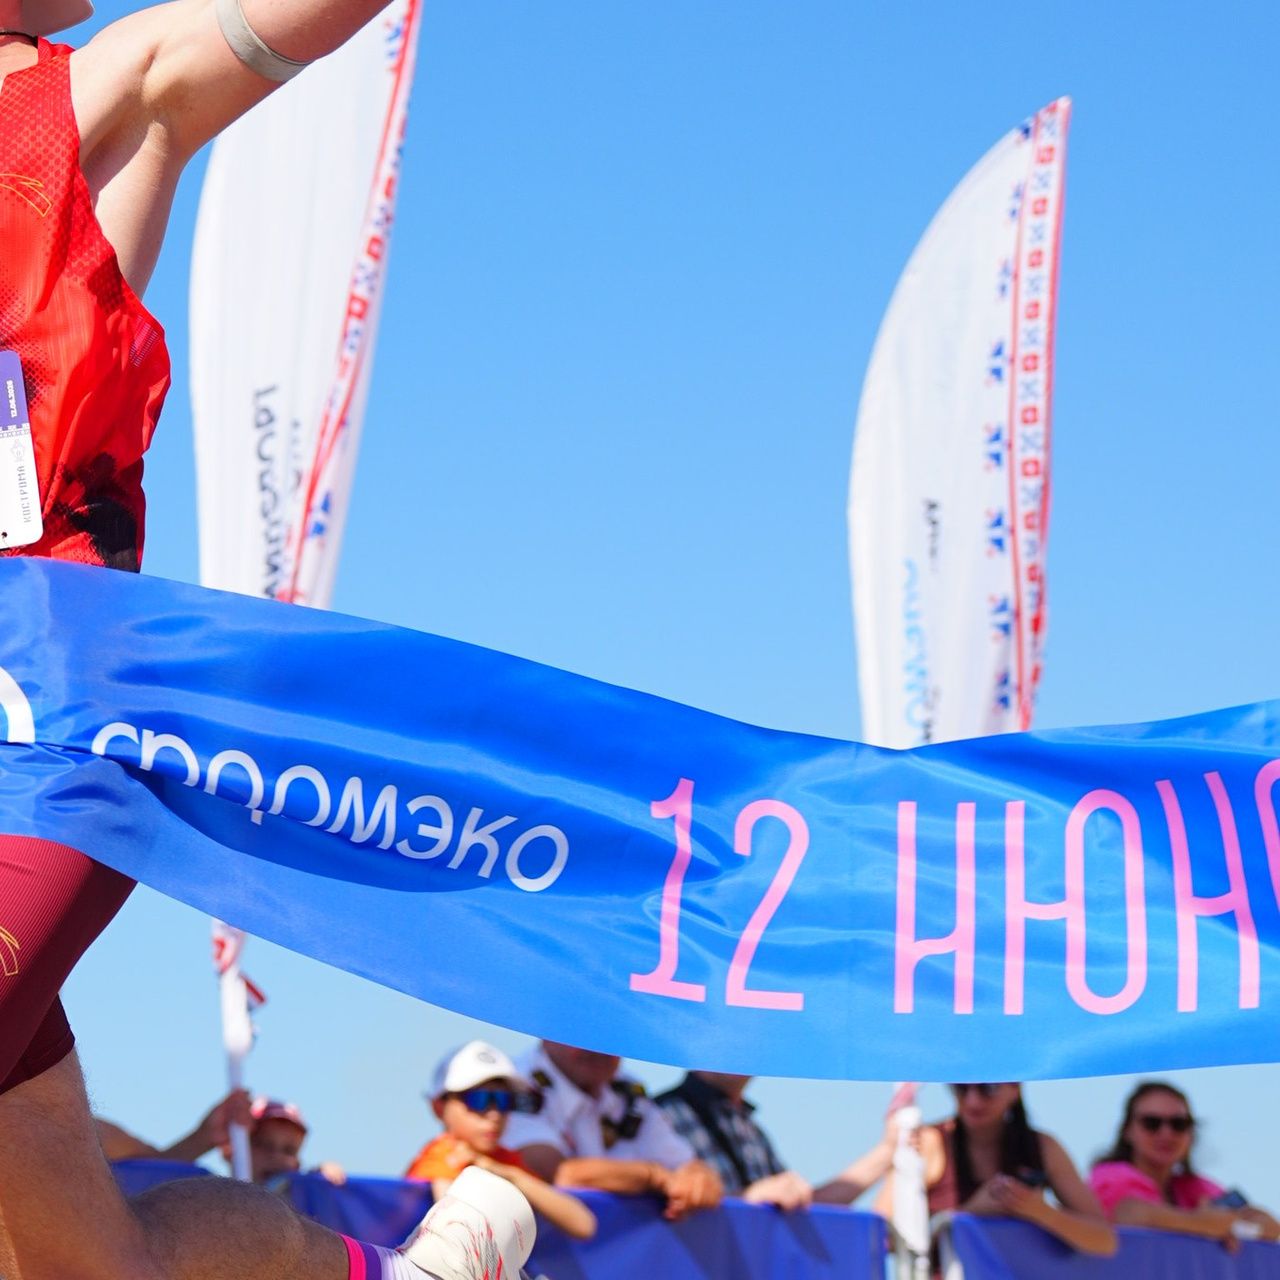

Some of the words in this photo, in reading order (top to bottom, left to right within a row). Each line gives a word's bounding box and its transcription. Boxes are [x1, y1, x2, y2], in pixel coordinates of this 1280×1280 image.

[16, 465, 32, 524] КОСТРОМА
[629, 776, 811, 1012] 12
[893, 758, 1280, 1016] ИЮН
